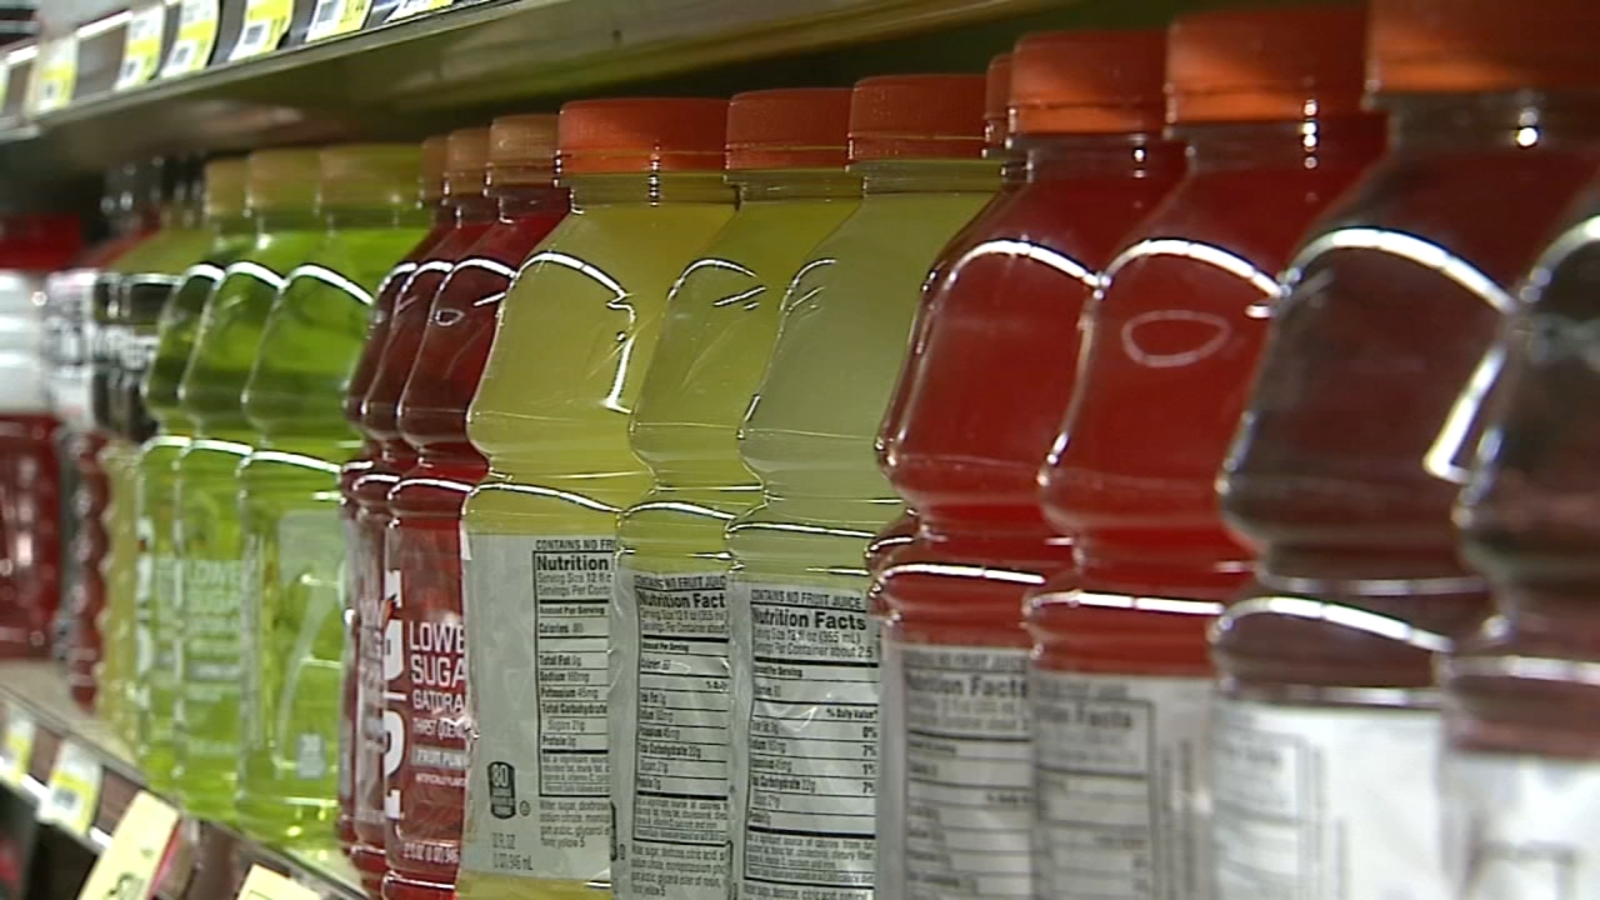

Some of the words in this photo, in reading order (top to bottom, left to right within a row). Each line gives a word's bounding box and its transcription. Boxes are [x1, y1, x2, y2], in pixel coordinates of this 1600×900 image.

[536, 539, 581, 550] CONTAINS
[583, 539, 598, 550] NO
[536, 554, 609, 571] Nutrition
[694, 592, 726, 609] Fact
[832, 595, 863, 609] JUICE
[814, 611, 868, 631] Facts
[409, 620, 465, 654] LOWE
[411, 653, 467, 689] SUGA
